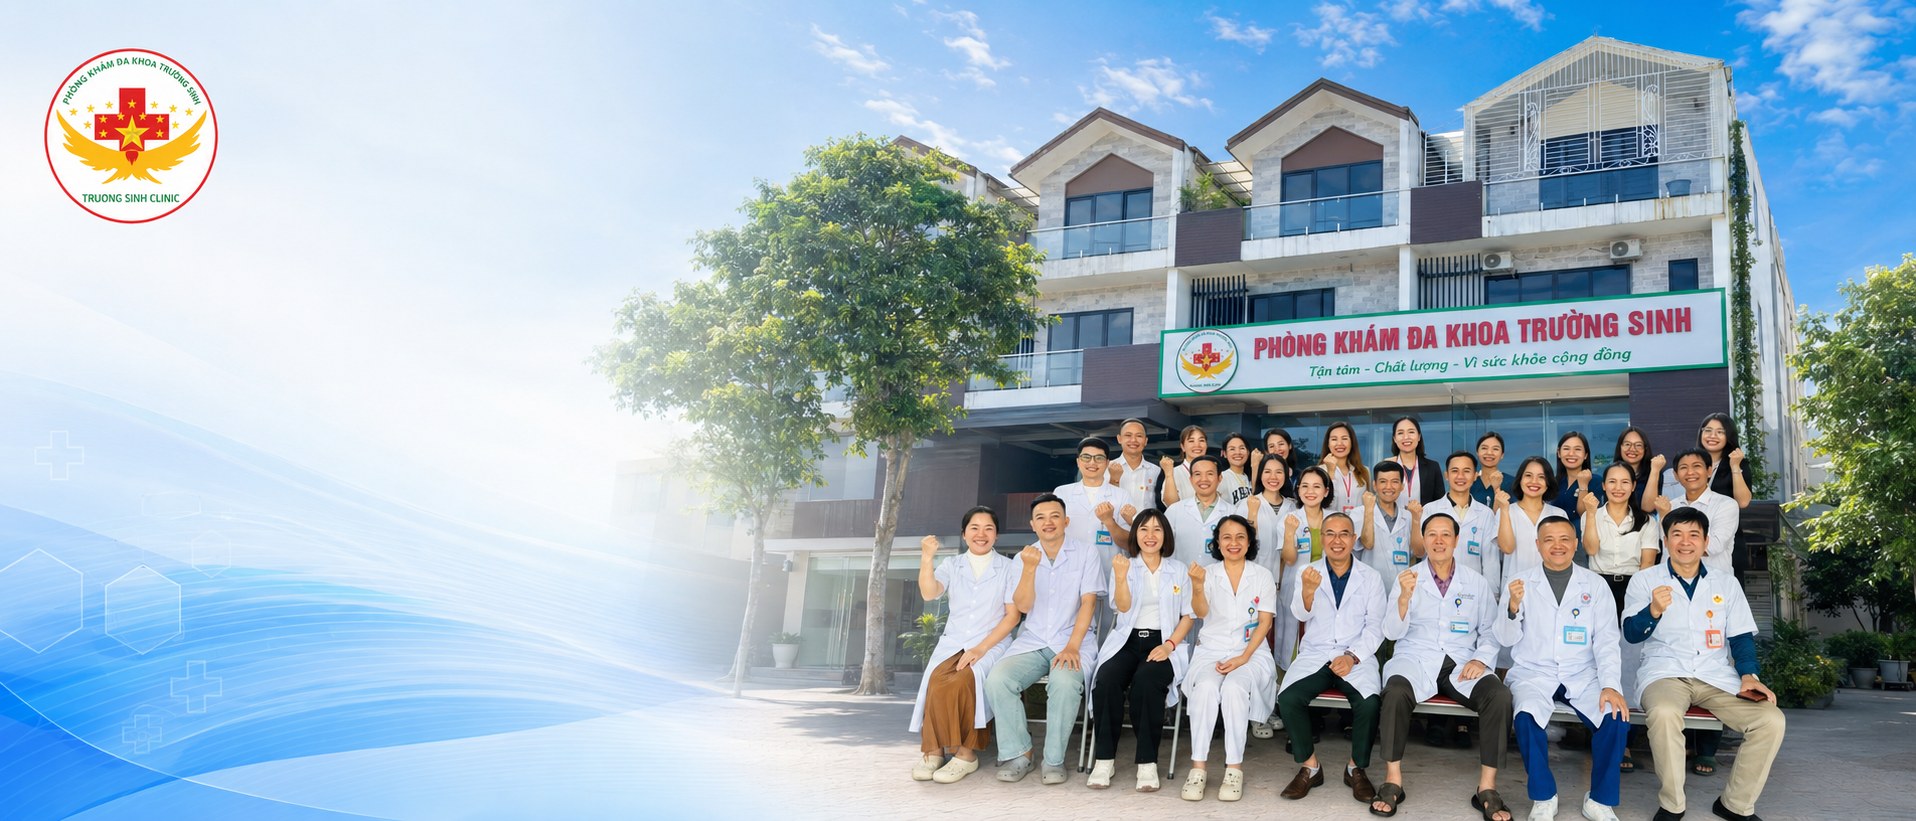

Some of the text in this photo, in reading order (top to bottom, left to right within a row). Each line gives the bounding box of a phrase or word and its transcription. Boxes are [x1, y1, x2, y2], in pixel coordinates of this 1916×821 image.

[1254, 331, 1327, 360] PHÒNG
[1334, 324, 1399, 354] KHÁM
[1407, 325, 1438, 349] ĐA
[1445, 320, 1510, 348] KHOA
[1517, 309, 1619, 342] TRƯỜNG
[1628, 307, 1692, 335] SINH
[1309, 365, 1333, 379] Tận
[1336, 364, 1360, 375] tâm
[1374, 359, 1407, 373] Chất
[1410, 359, 1449, 373] lượng
[1464, 356, 1478, 368] Vì
[1481, 355, 1507, 368] sức
[1552, 351, 1589, 366] cộng
[1593, 346, 1632, 363] đồng
